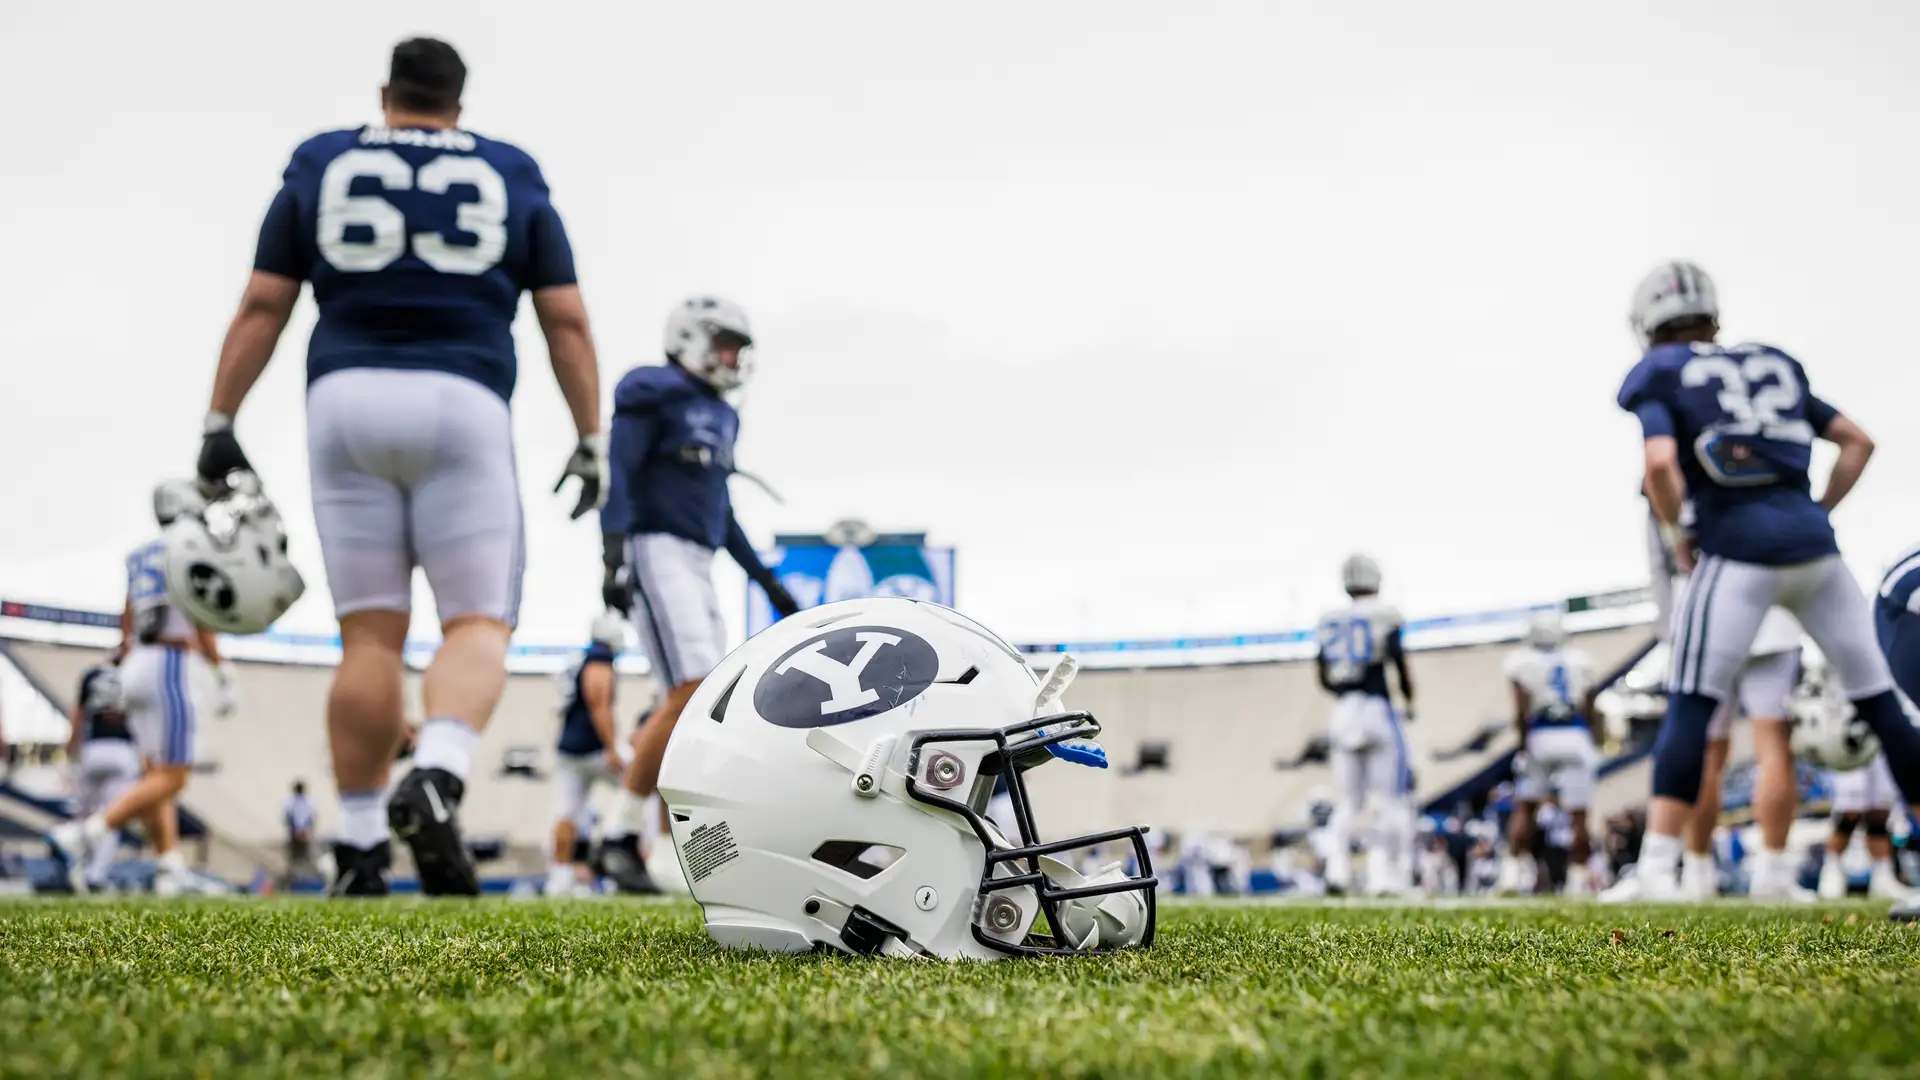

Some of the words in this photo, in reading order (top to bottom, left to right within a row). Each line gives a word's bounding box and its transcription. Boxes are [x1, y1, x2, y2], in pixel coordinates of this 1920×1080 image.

[316, 147, 509, 276] 63
[1680, 354, 1816, 446] 32
[774, 631, 903, 715] Y
[1318, 617, 1373, 665] 20
